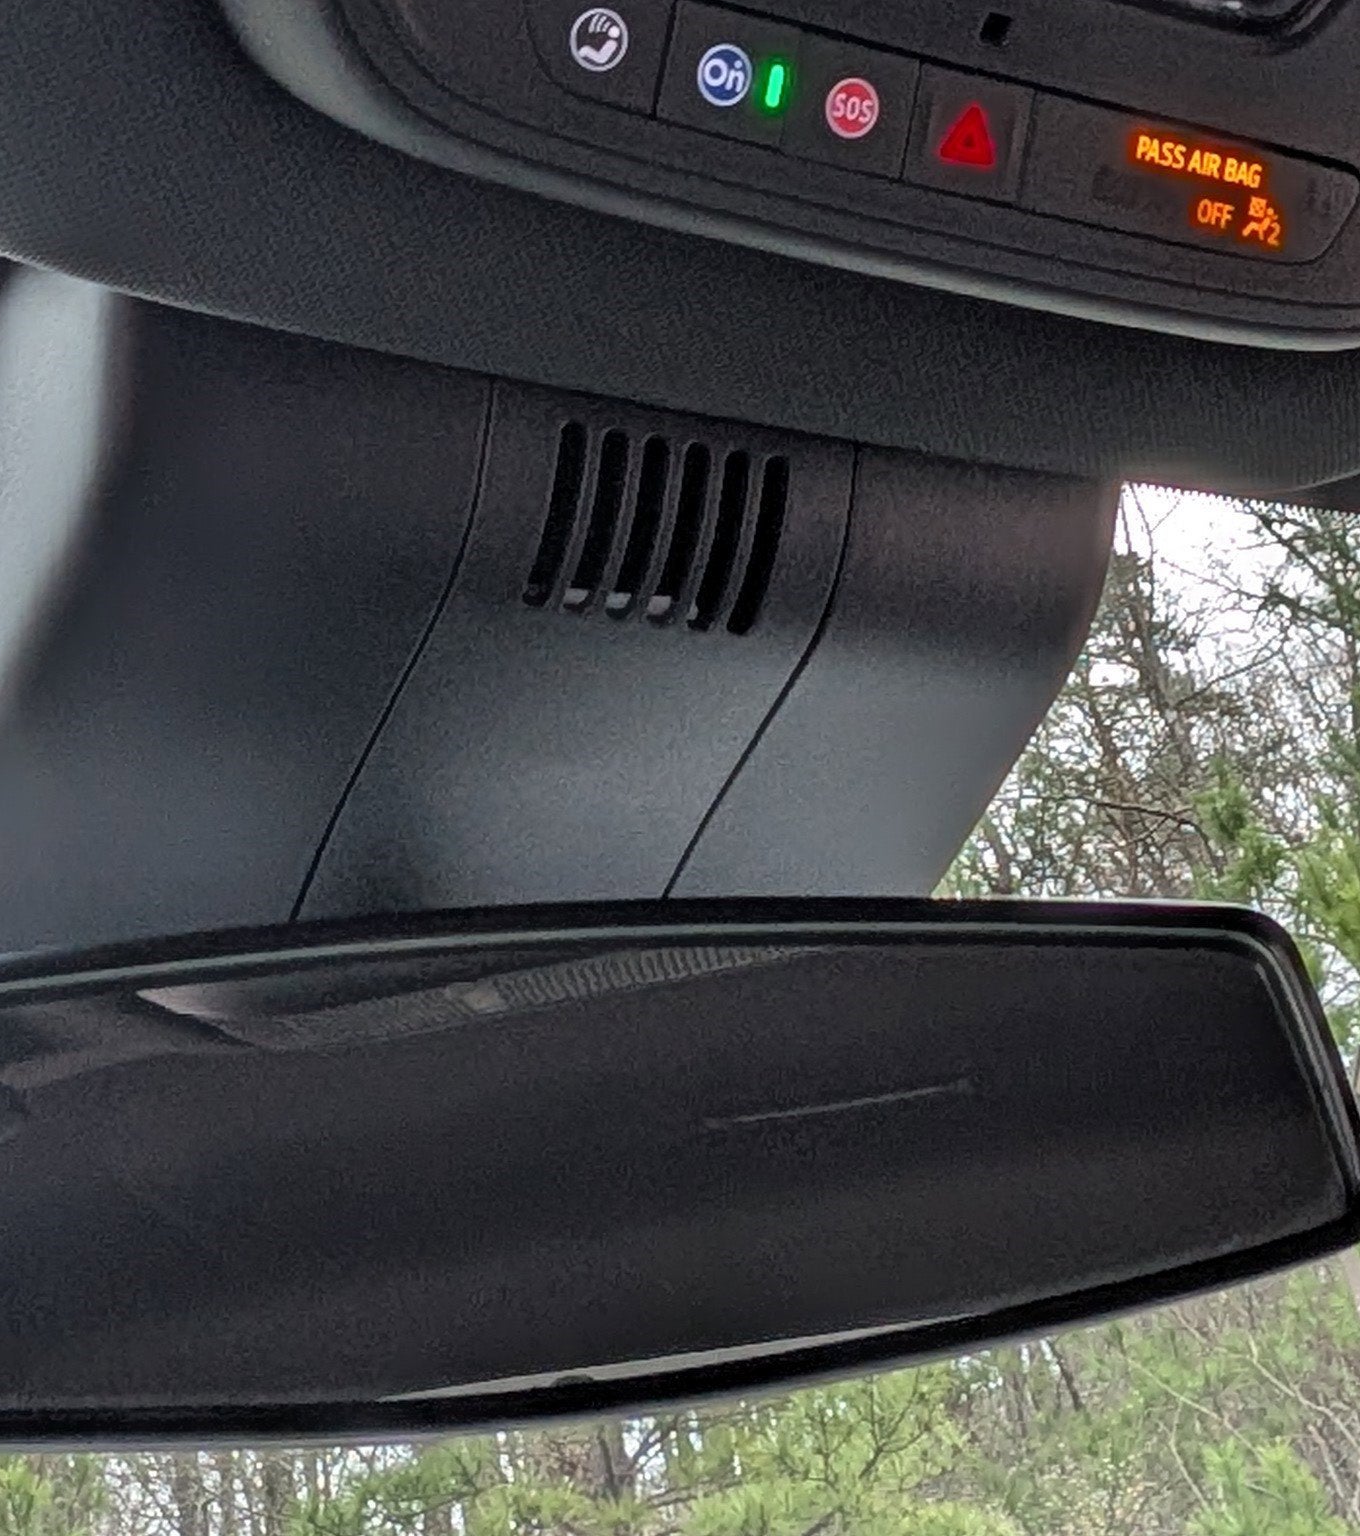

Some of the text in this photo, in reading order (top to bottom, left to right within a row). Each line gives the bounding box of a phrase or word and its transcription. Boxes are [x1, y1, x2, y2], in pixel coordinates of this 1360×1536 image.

[703, 58, 745, 93] On
[832, 93, 874, 124] SOS
[1136, 135, 1263, 189] PASS AIR BAG
[1197, 199, 1235, 229] OFF
